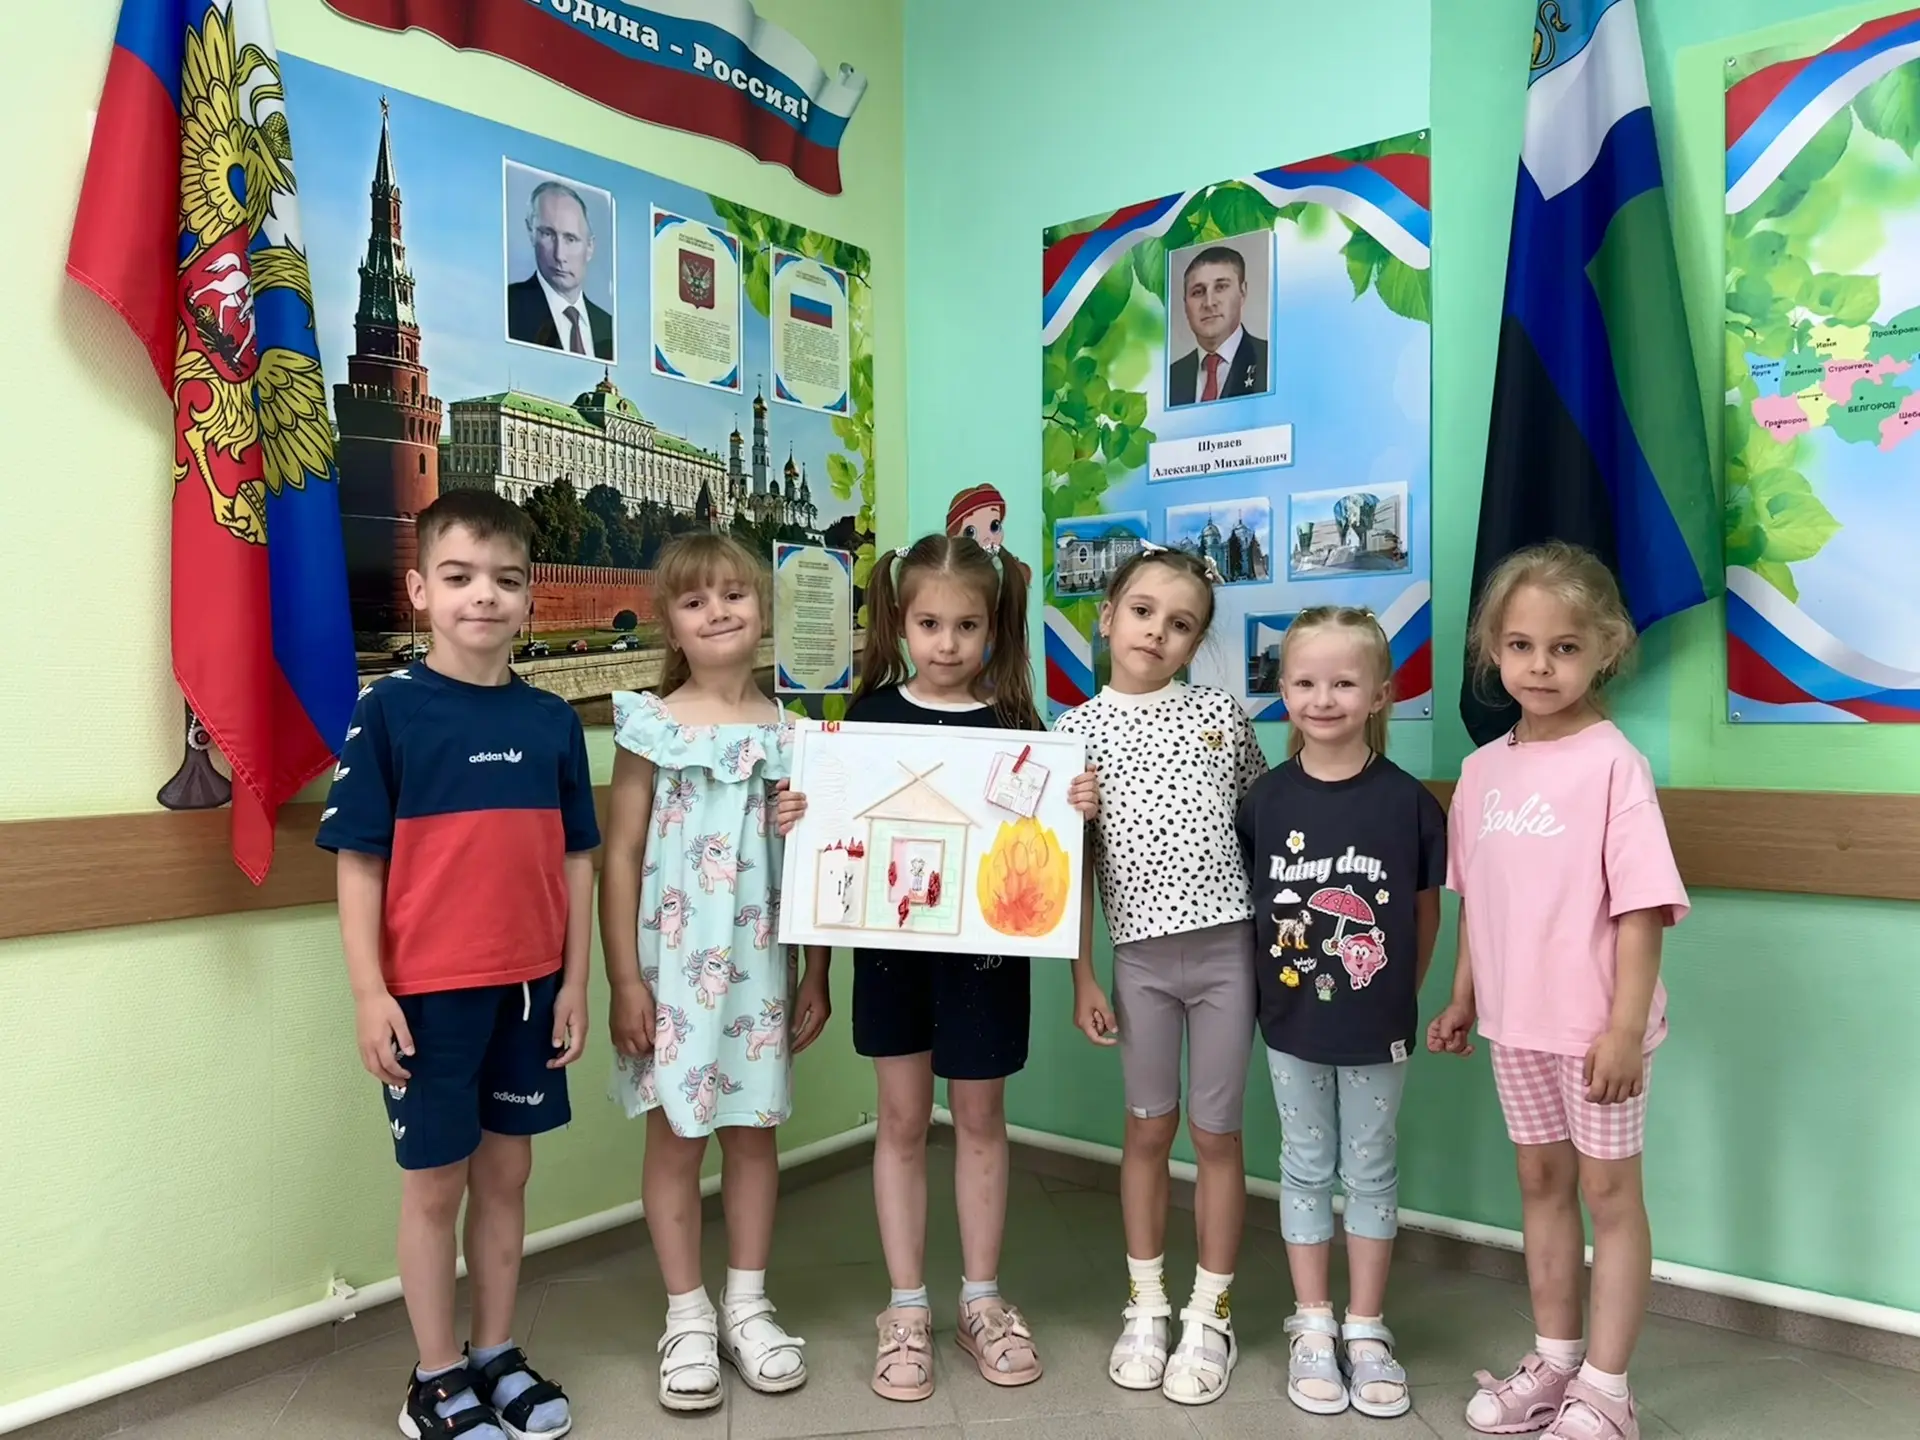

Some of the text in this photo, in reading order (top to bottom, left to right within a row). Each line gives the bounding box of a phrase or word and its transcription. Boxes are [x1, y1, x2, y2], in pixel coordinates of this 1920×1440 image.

[532, 0, 660, 50] одина
[692, 43, 809, 122] Россия!
[1785, 367, 1823, 376] Ракитное
[1828, 362, 1874, 373] Строитель
[1848, 401, 1896, 413] БЕЛГОРОД
[1764, 417, 1808, 427] Грайворон
[1197, 438, 1242, 453] Шуваев
[1153, 453, 1287, 477] Александр Михайлович
[469, 752, 502, 763] adidas
[1478, 788, 1566, 840] Barbie
[1268, 845, 1388, 884] Rainy day.
[493, 1091, 525, 1103] adidas
